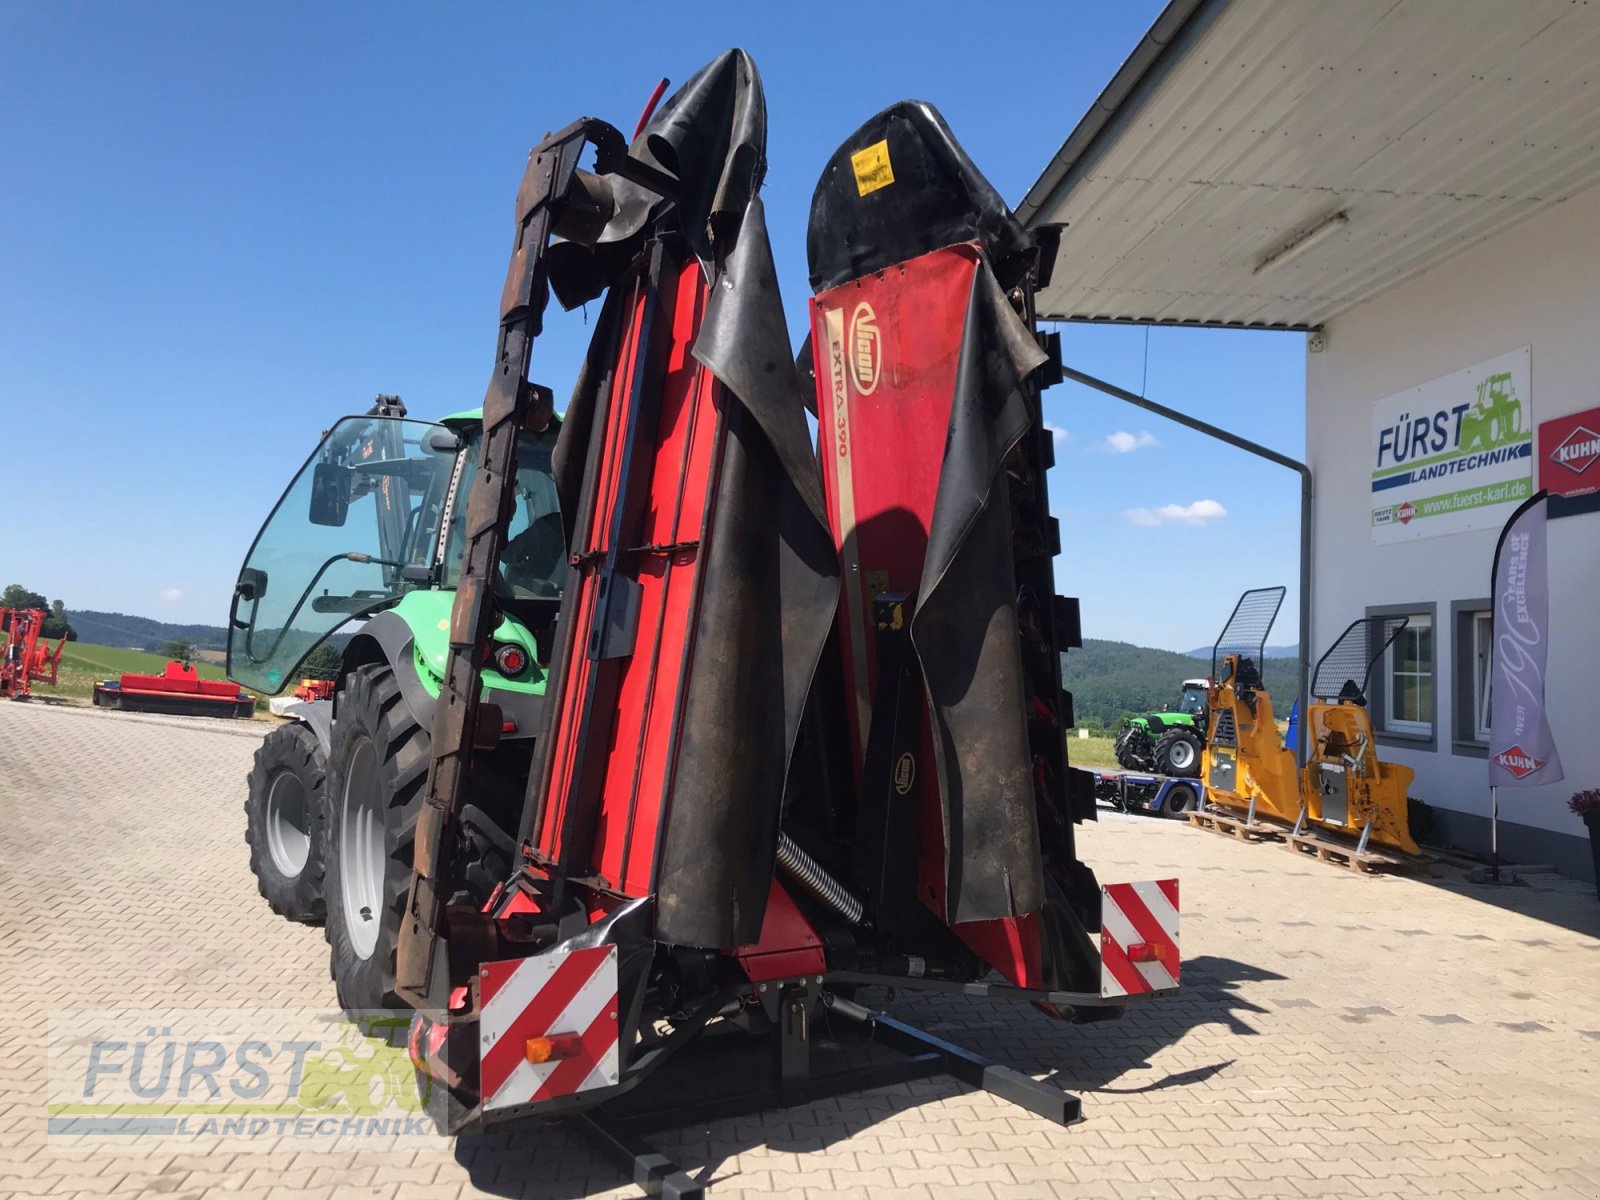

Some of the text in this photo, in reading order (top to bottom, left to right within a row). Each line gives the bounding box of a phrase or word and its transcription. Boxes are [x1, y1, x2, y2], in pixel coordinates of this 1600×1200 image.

[852, 305, 880, 393] Vicon
[832, 340, 847, 457] EXTRA 390
[1377, 403, 1470, 467] FÜRST
[1410, 445, 1522, 484] LANDTECHNIK
[1560, 438, 1600, 462] KUHN
[1423, 481, 1526, 514] www.fuerst-karl.de
[1508, 533, 1520, 602] YEARS OF
[1516, 532, 1530, 624] EXCELLENCE
[1500, 755, 1537, 769] KUHN
